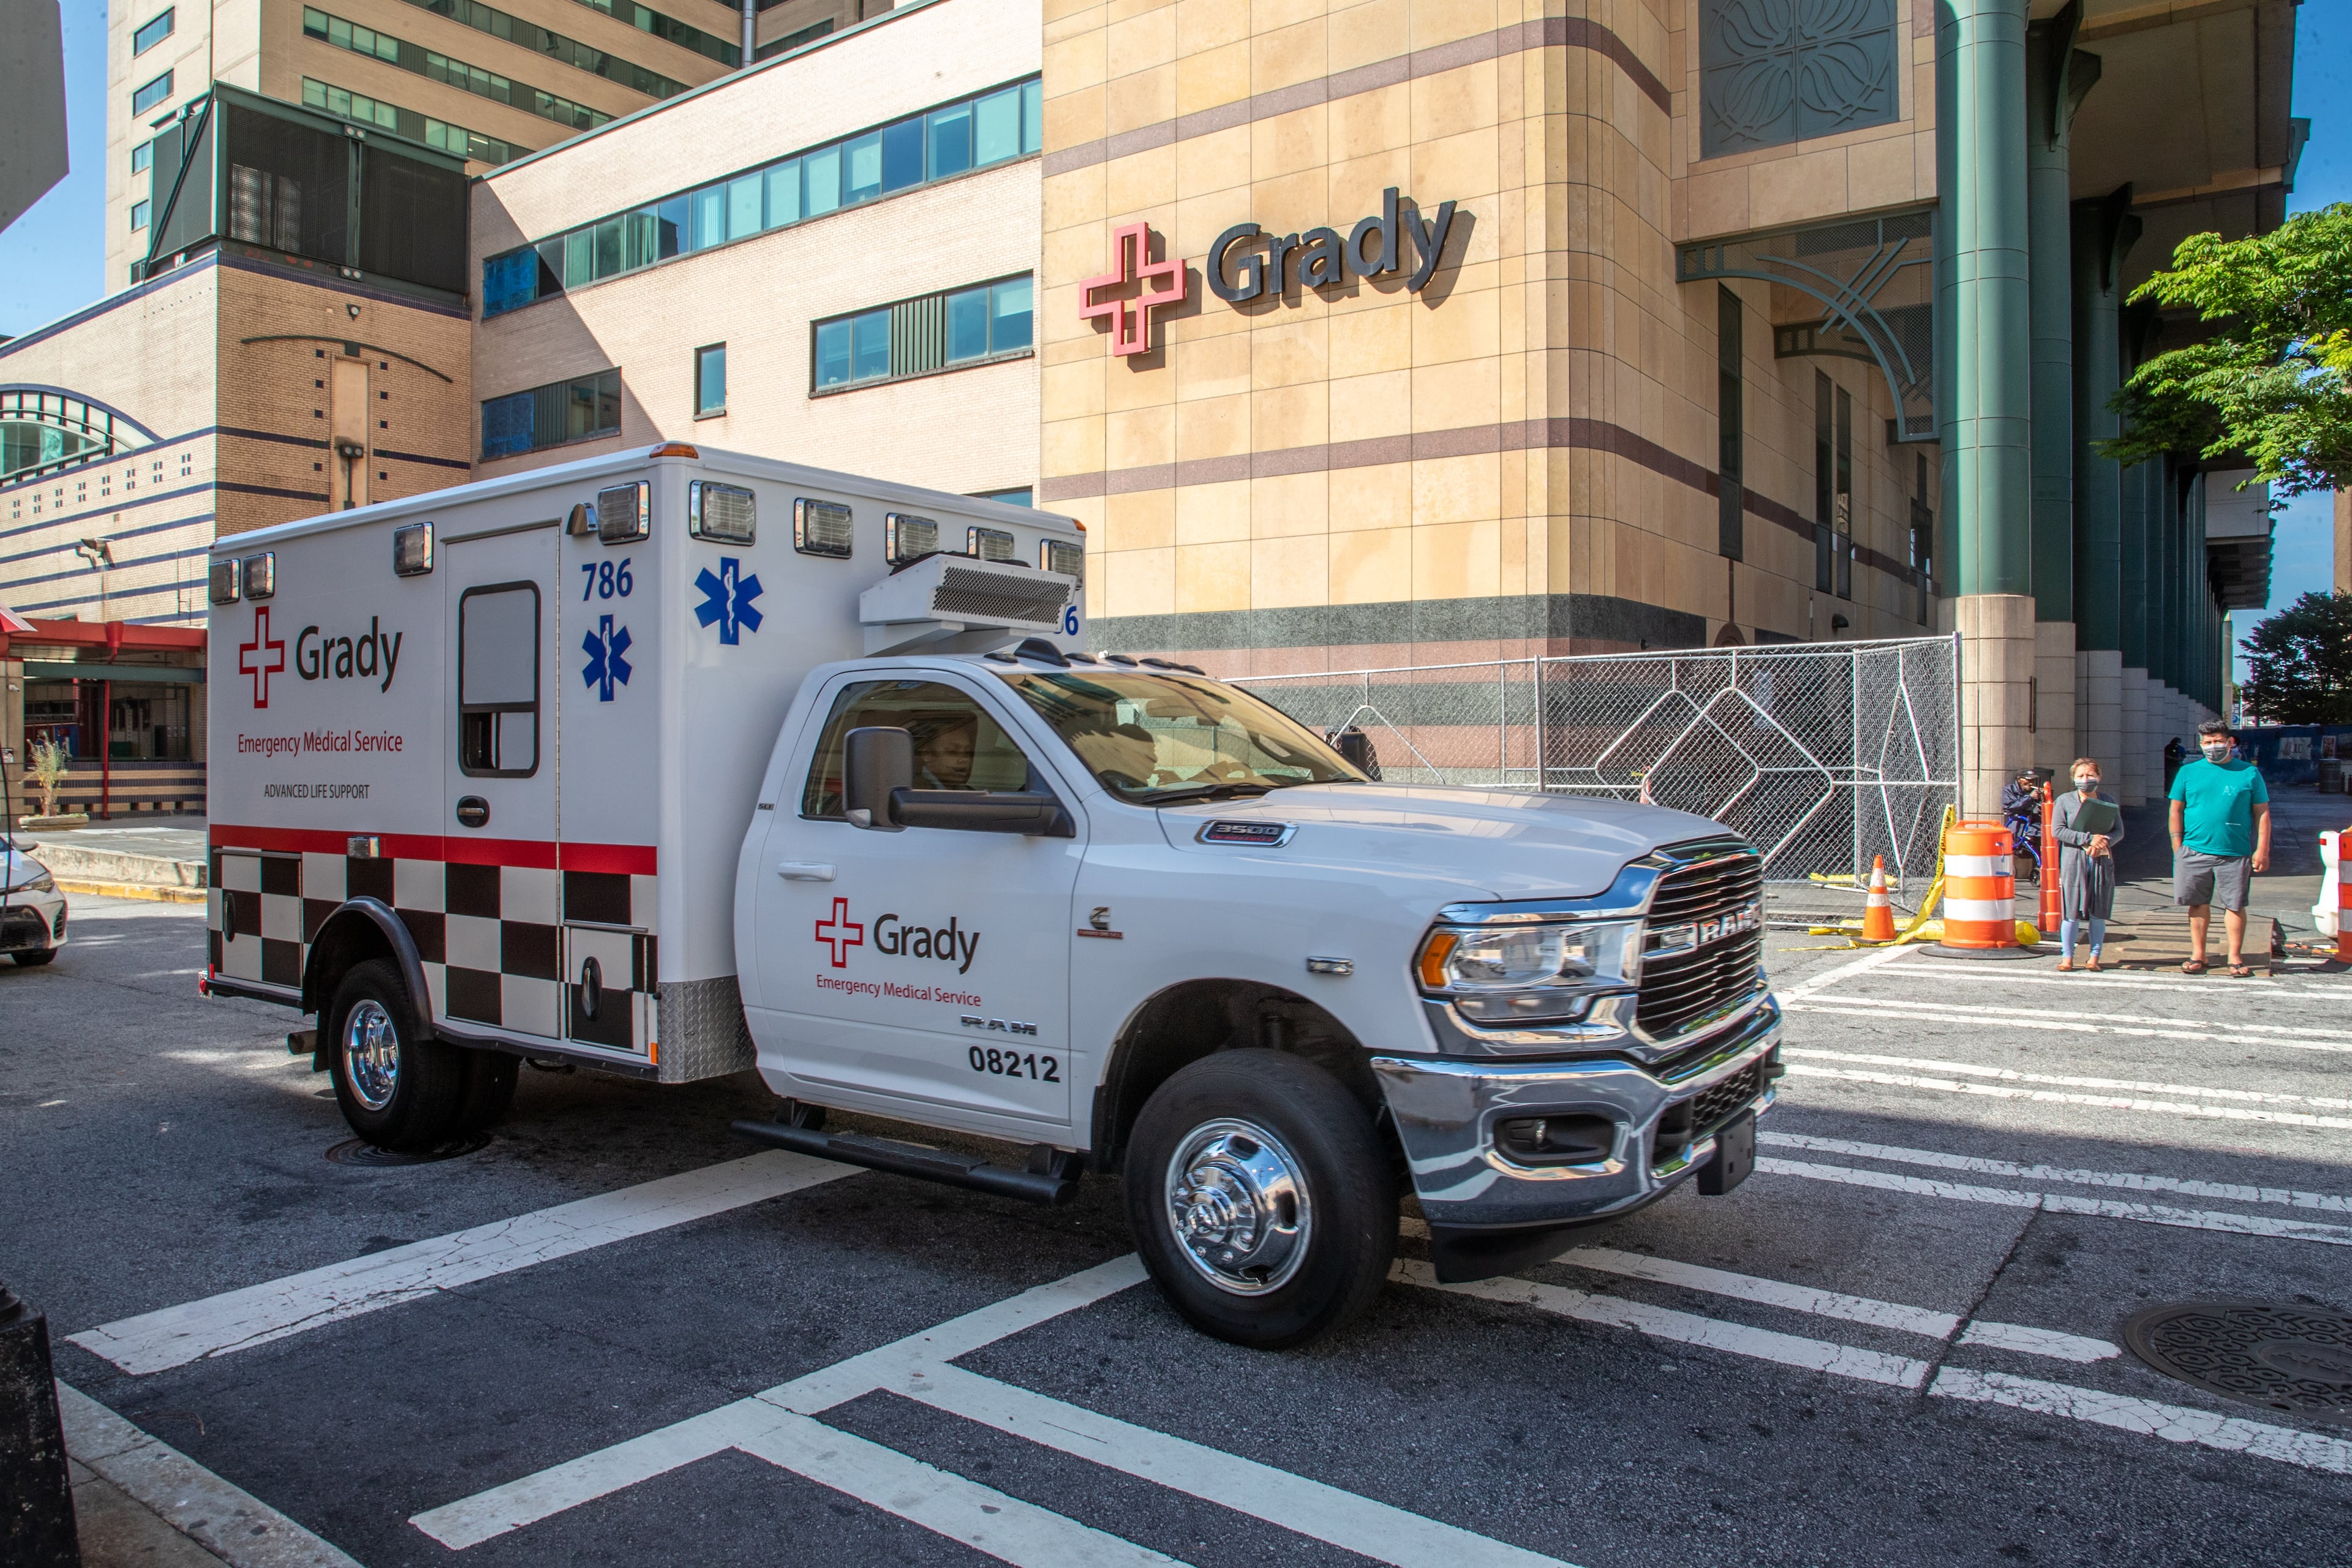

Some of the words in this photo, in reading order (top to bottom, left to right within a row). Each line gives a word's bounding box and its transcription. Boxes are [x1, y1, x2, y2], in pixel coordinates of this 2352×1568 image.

[1207, 187, 1457, 303] Grady
[581, 557, 633, 601] 786
[295, 616, 403, 694] Grady
[238, 734, 301, 758] Emergency
[303, 729, 351, 752] Medical
[354, 730, 403, 752] Service
[264, 784, 309, 798] ADVANCED
[311, 784, 328, 799] LIFE
[329, 784, 370, 799] SUPPORT
[1216, 824, 1280, 836] 3500
[873, 913, 981, 975] Grady
[816, 974, 881, 998] Emergency
[884, 981, 932, 1001] Medical
[934, 987, 981, 1007] Service
[960, 1014, 1038, 1036] RAM
[968, 1046, 1060, 1084] 08212
